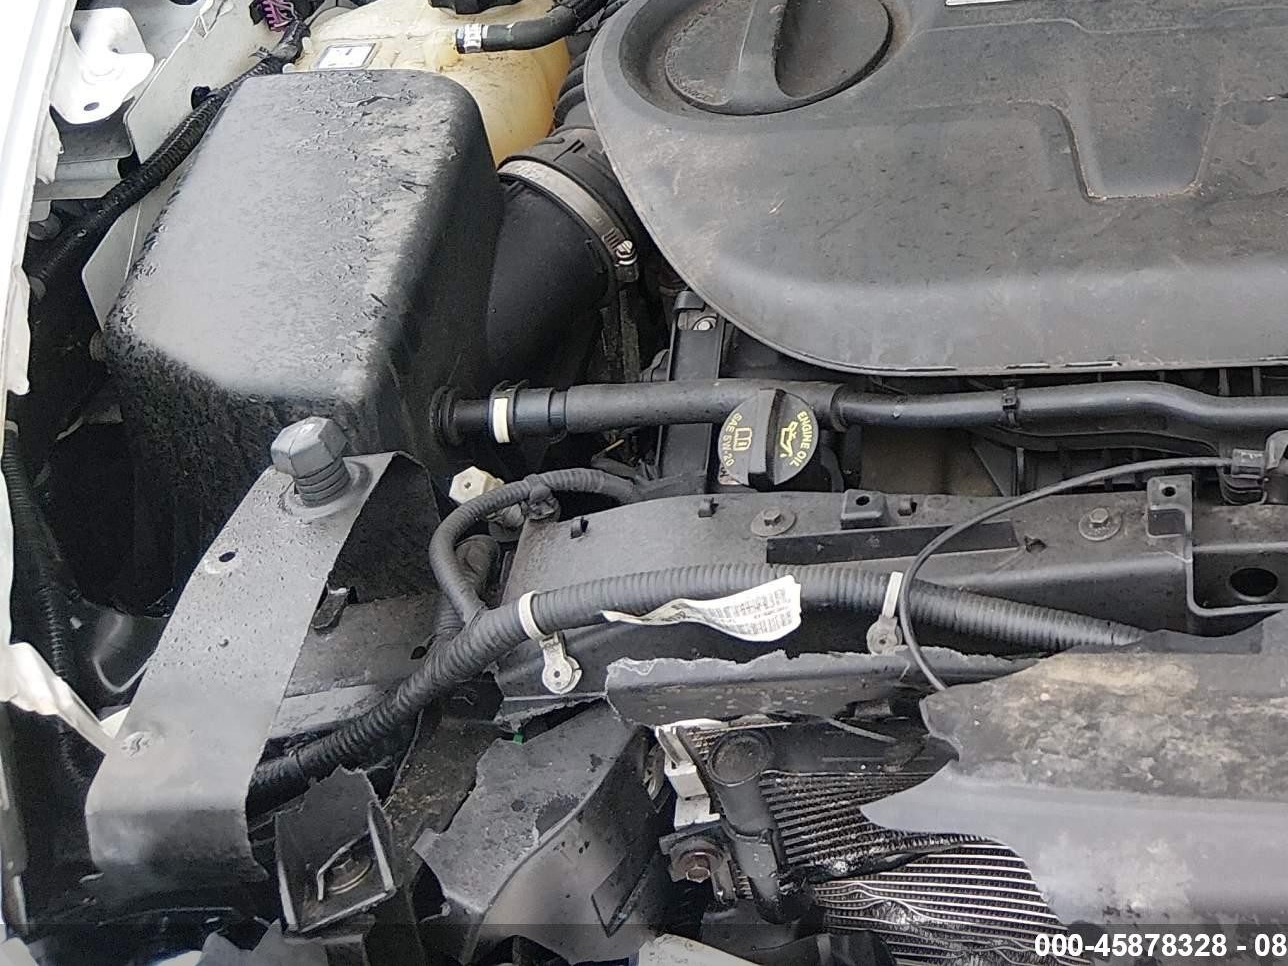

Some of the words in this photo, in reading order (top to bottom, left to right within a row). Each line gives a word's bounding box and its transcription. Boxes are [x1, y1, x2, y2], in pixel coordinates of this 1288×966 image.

[726, 412, 743, 433] SAE
[797, 411, 813, 449] ENGINE
[789, 451, 807, 467] OIL
